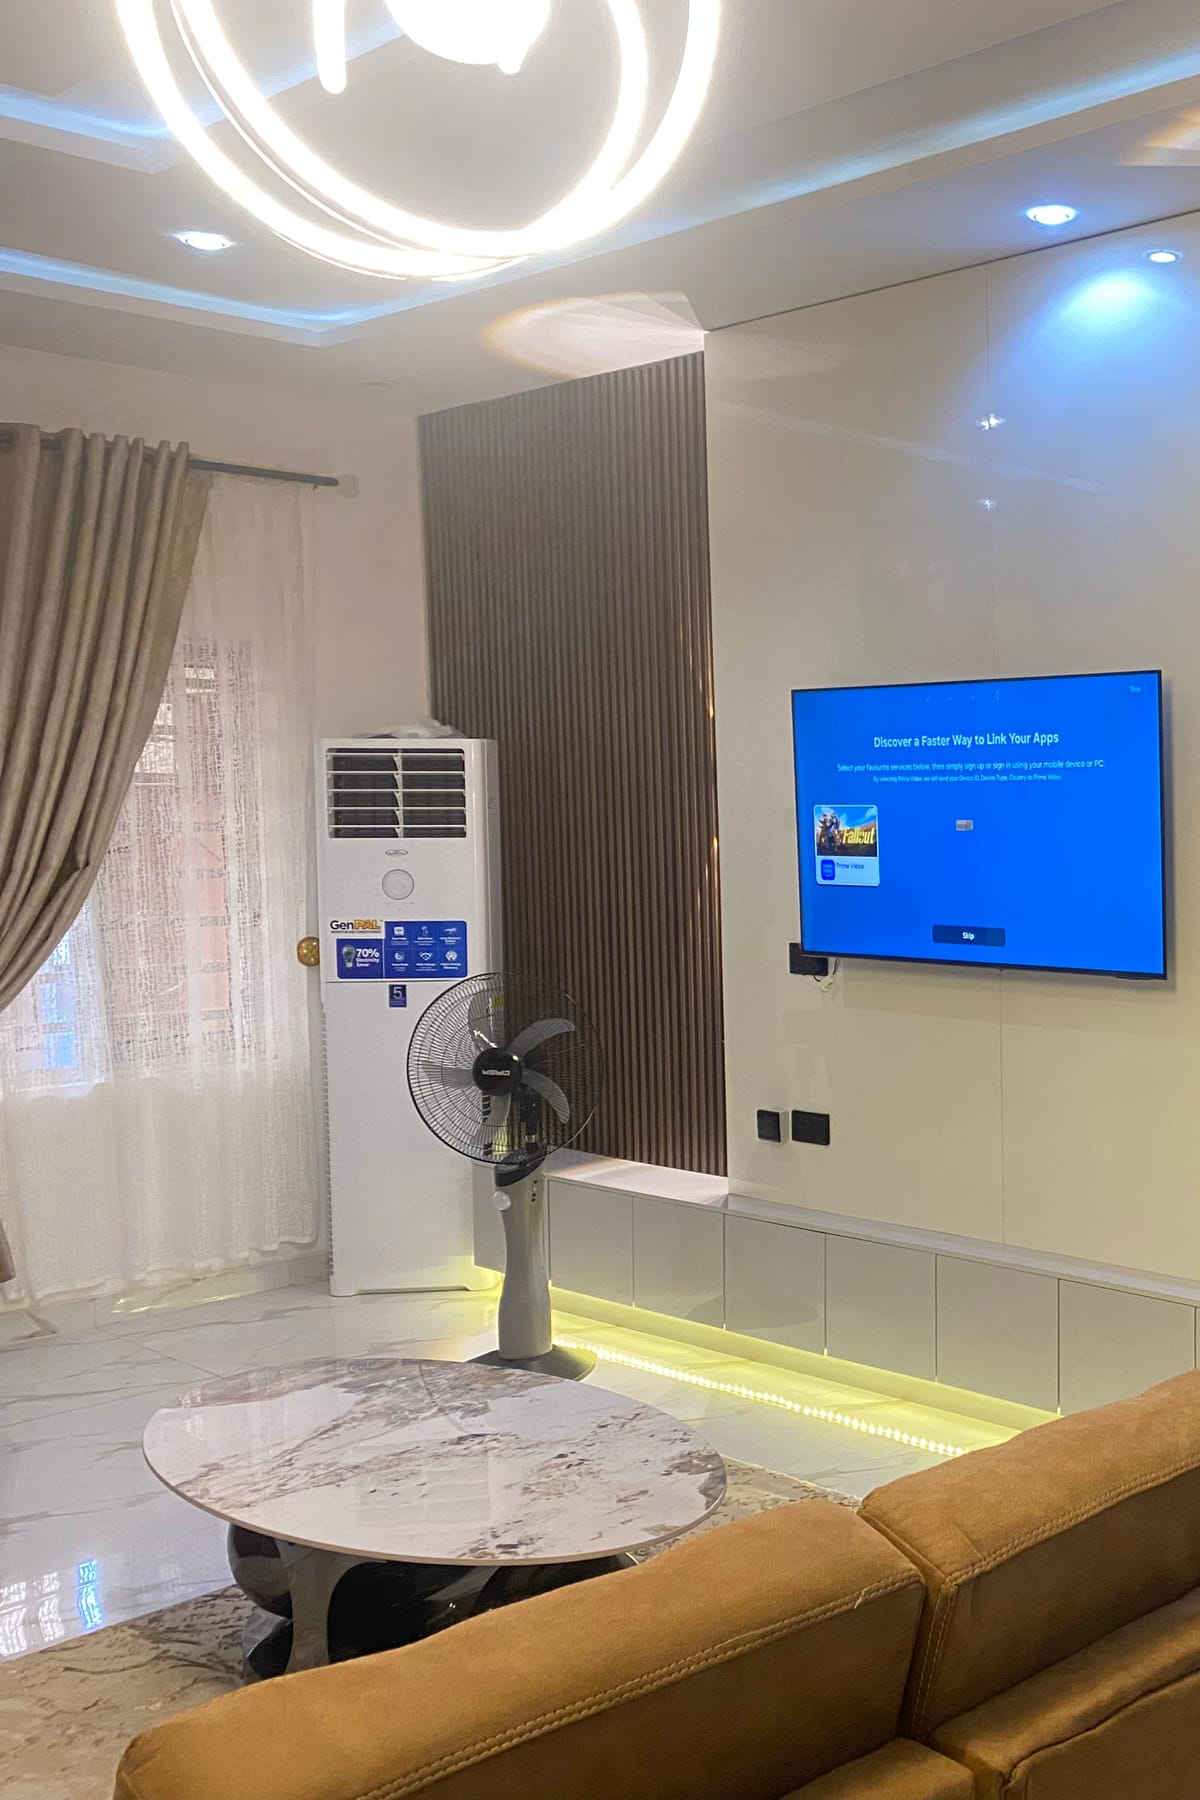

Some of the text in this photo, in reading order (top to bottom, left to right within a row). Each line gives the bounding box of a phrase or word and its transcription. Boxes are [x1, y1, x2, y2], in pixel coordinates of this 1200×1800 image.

[873, 732, 1059, 748] Discover a Faster Way to Link Your Apps
[932, 762, 944, 770] then
[945, 762, 963, 771] simply
[964, 763, 976, 771] sign
[977, 763, 985, 771] up
[993, 762, 1005, 771] sign
[1012, 761, 1028, 770] using
[1029, 761, 1042, 770] your
[1043, 760, 1064, 768] mobile
[1065, 760, 1085, 768] device
[842, 827, 875, 844] Fallout
[962, 931, 975, 940] Skip
[356, 948, 380, 958] 70%
[392, 986, 403, 1000] 5
